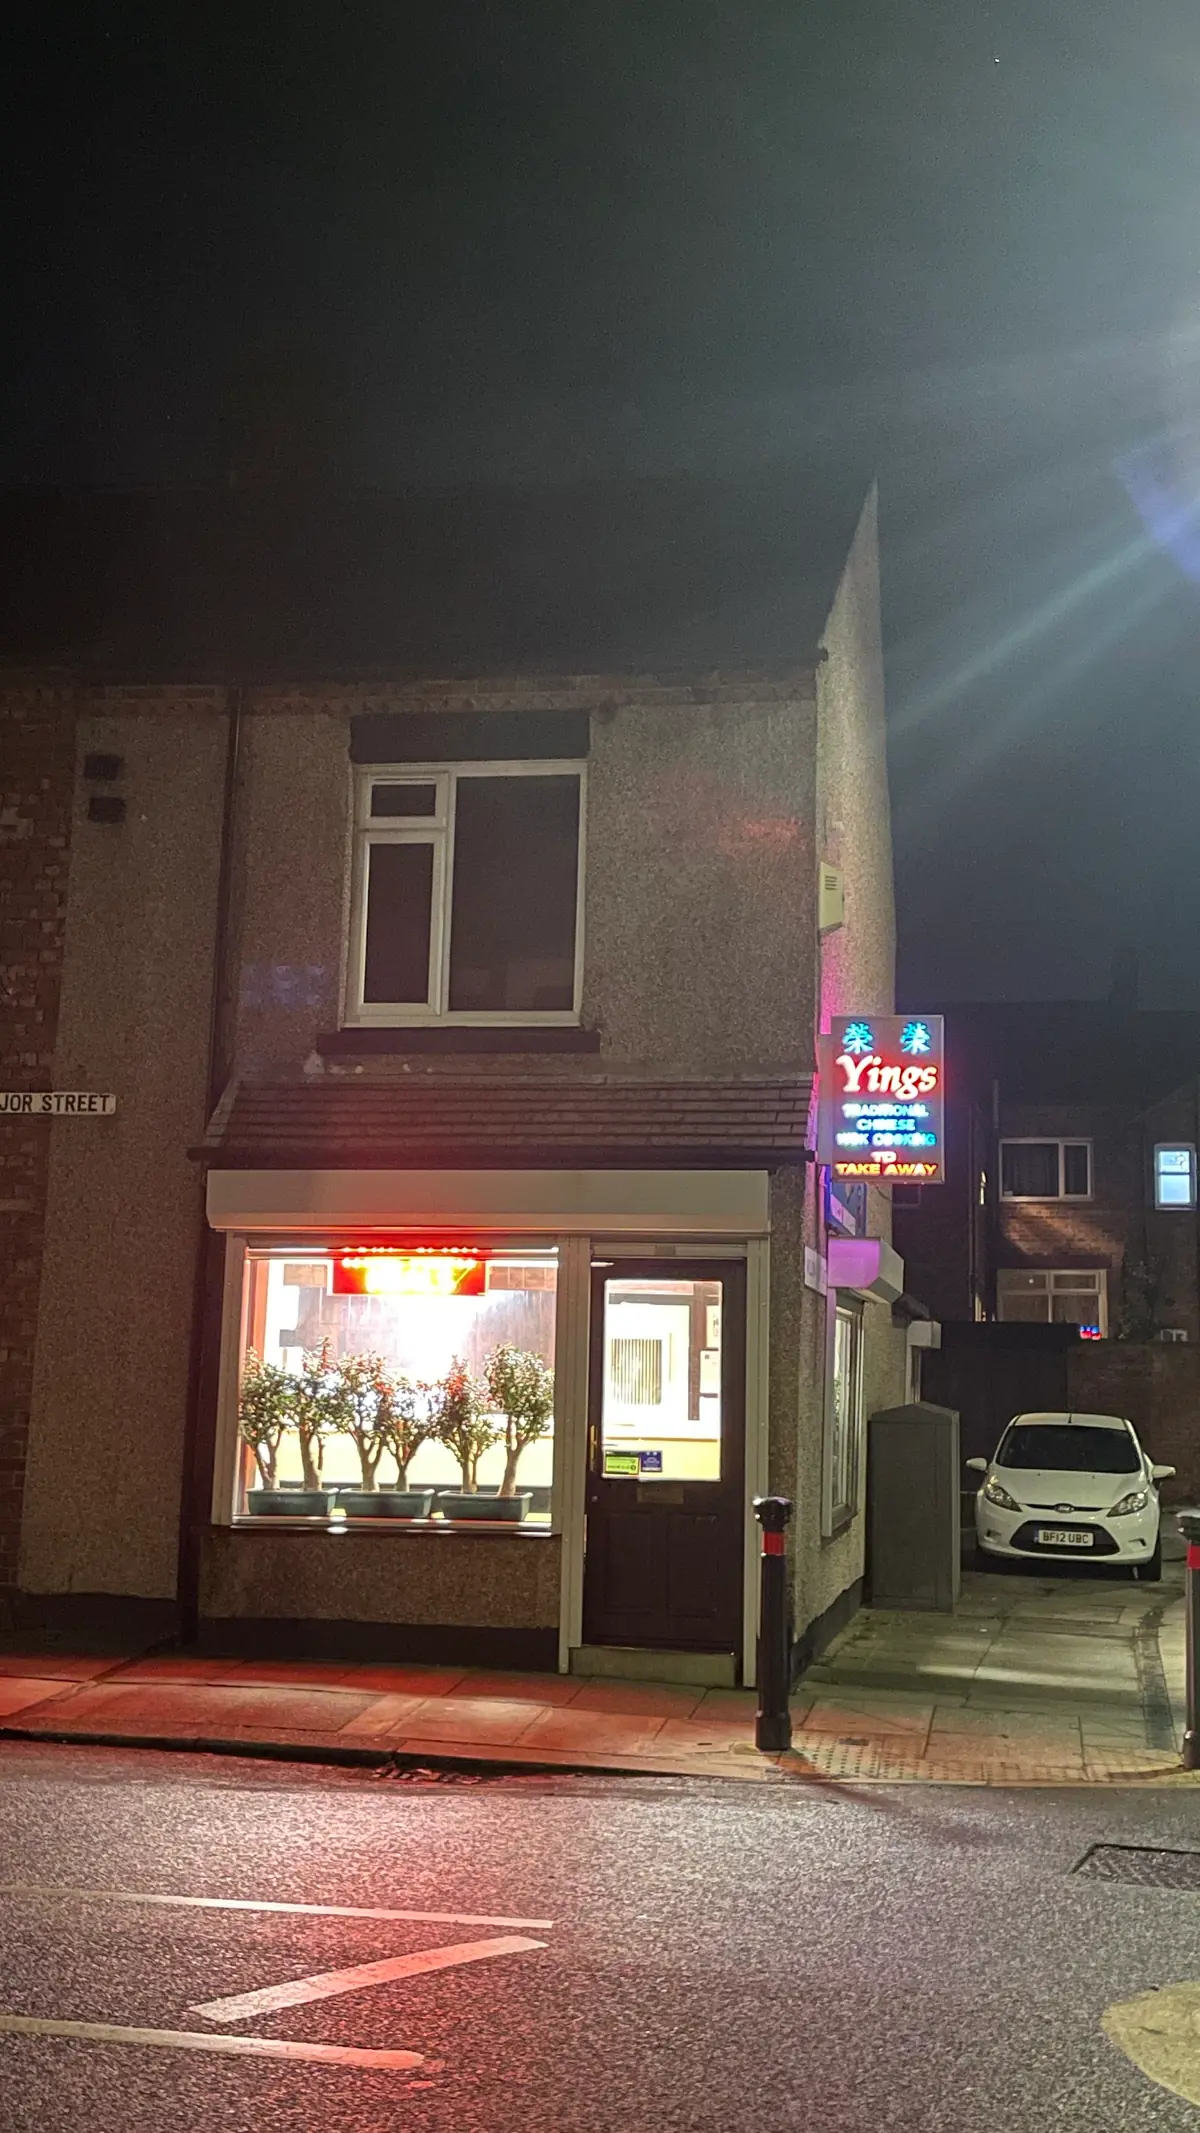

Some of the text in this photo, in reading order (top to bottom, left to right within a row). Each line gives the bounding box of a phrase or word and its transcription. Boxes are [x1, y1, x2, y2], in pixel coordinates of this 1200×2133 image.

[835, 1055, 938, 1100] Yings
[0, 1095, 110, 1112] JOR STREET
[842, 1103, 929, 1118] TRADITIONAL
[856, 1118, 916, 1131] CHINESE
[872, 1132, 936, 1146] COOKING
[871, 1151, 897, 1163] TO
[836, 1163, 937, 1176] TAKE AWAY
[1043, 1531, 1089, 1544] BF12 UBC
